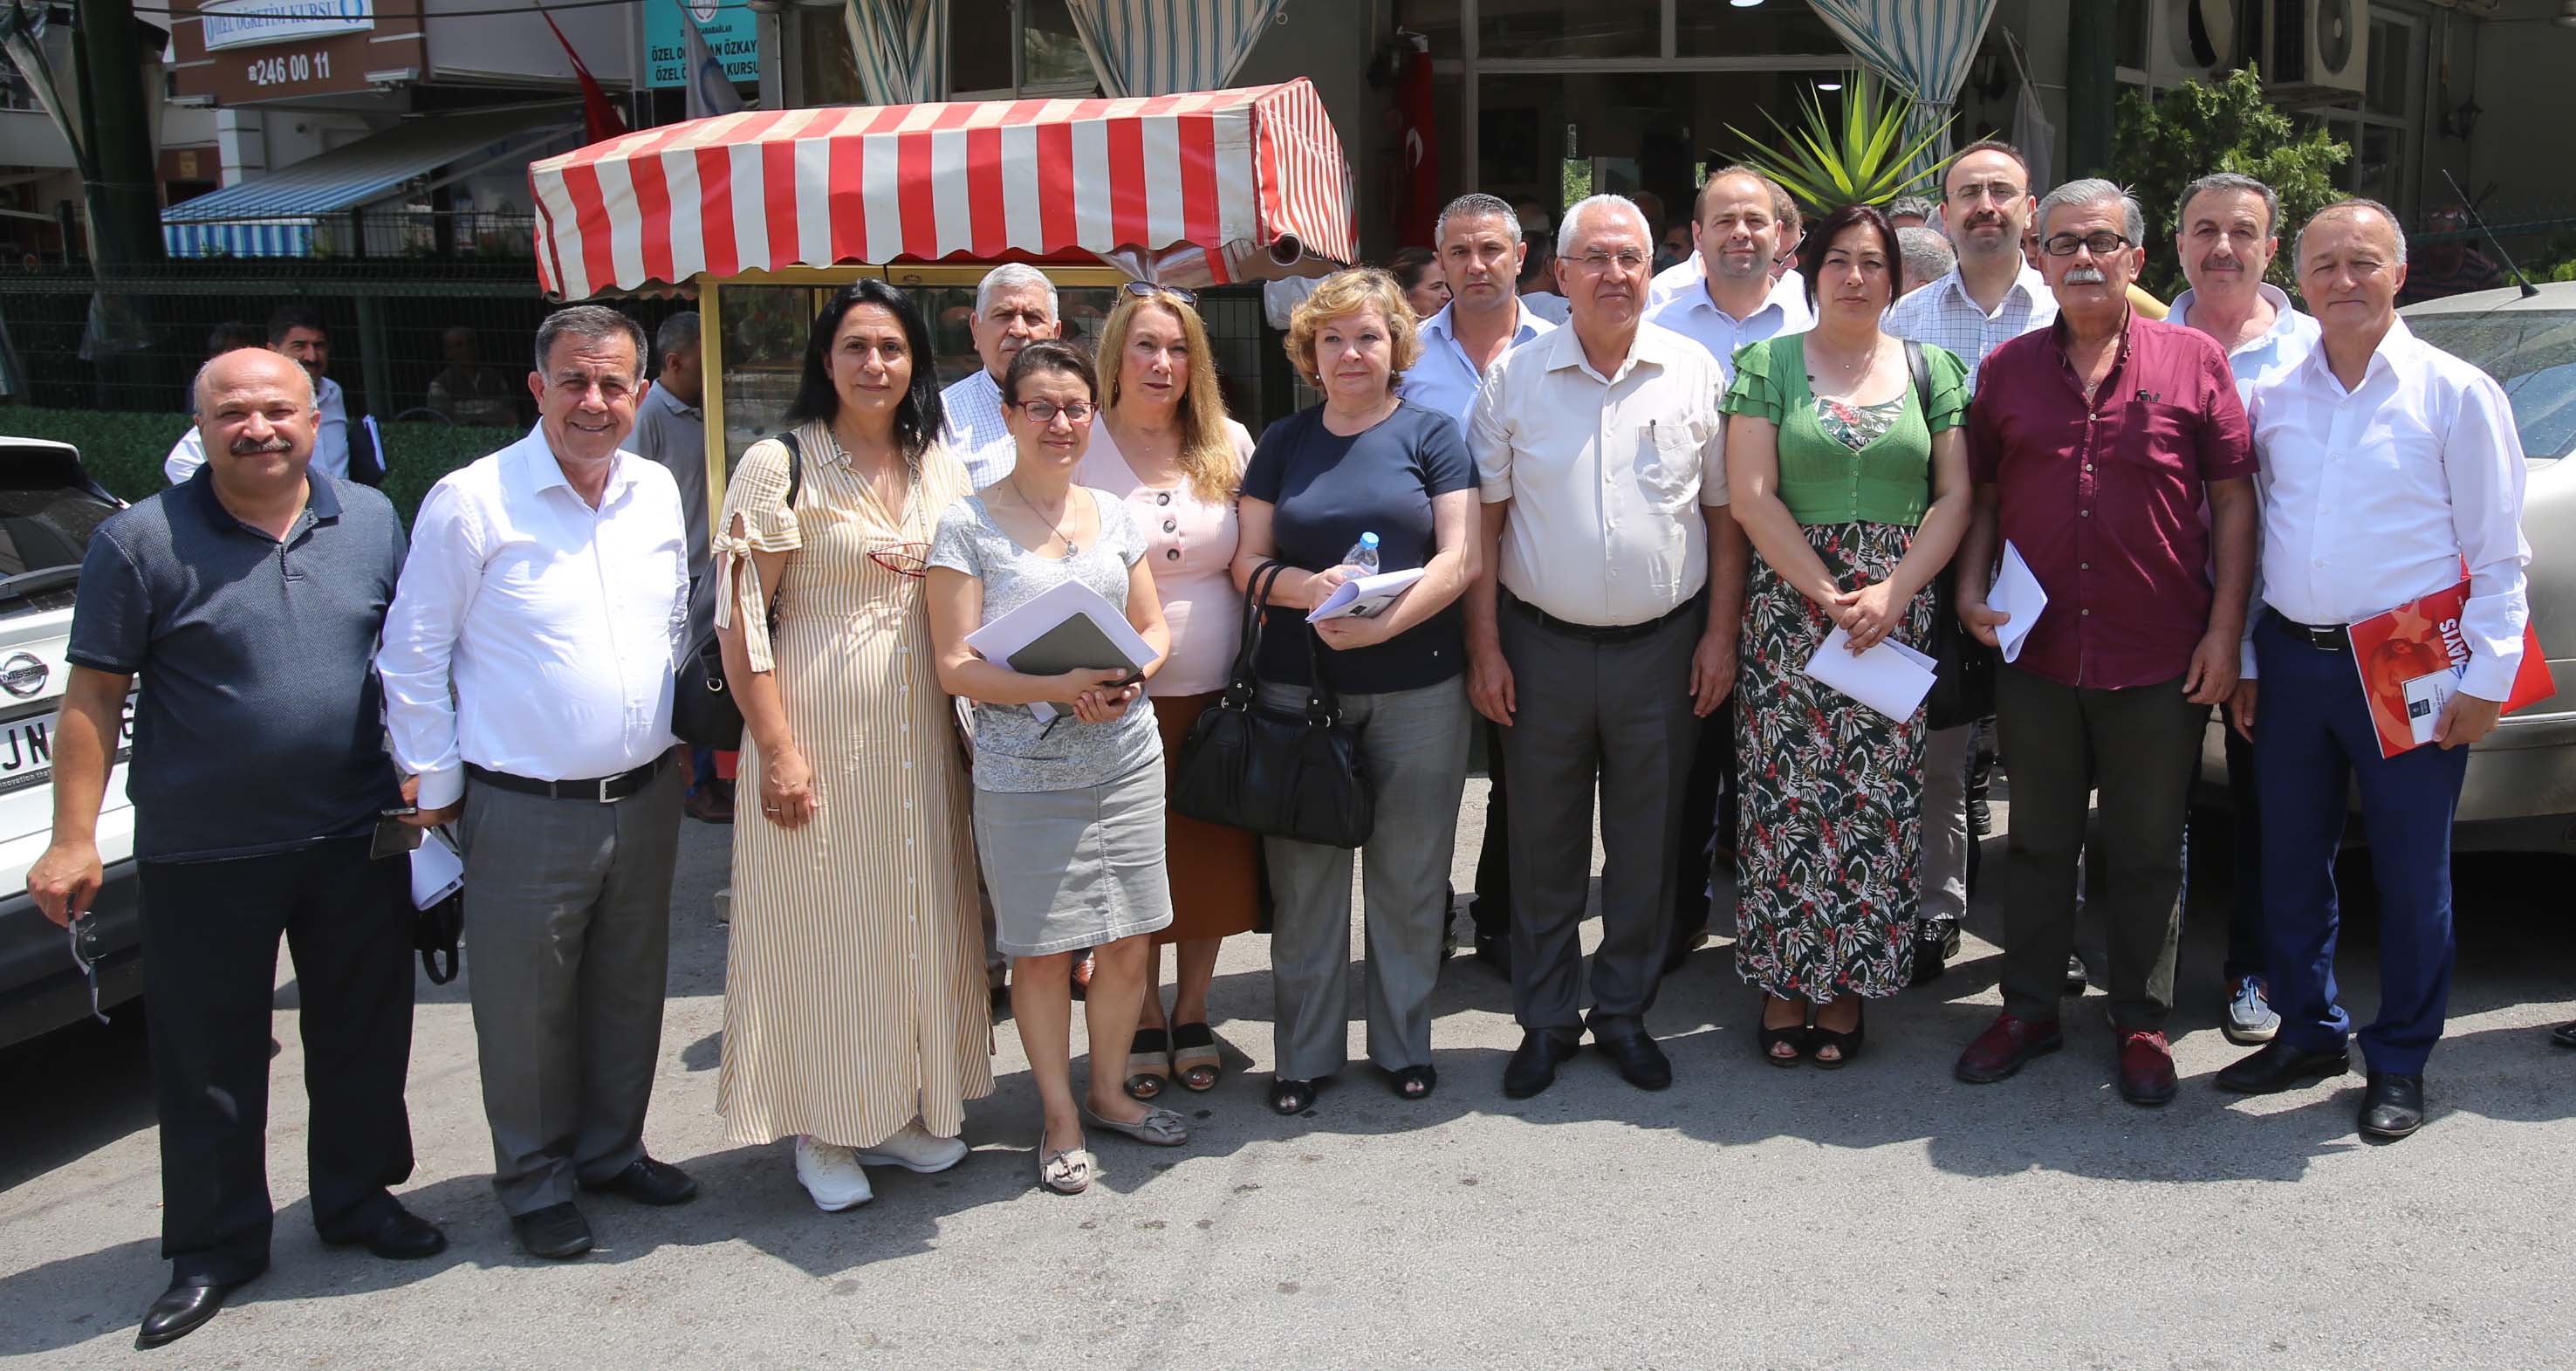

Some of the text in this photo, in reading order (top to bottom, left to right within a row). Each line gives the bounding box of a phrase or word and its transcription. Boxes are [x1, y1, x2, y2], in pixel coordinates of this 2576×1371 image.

[652, 45, 675, 62] ÖZEL
[257, 51, 330, 86] 246 00 11
[656, 65, 680, 81] ÖZEL
[2439, 618, 2469, 666] MAYIS
